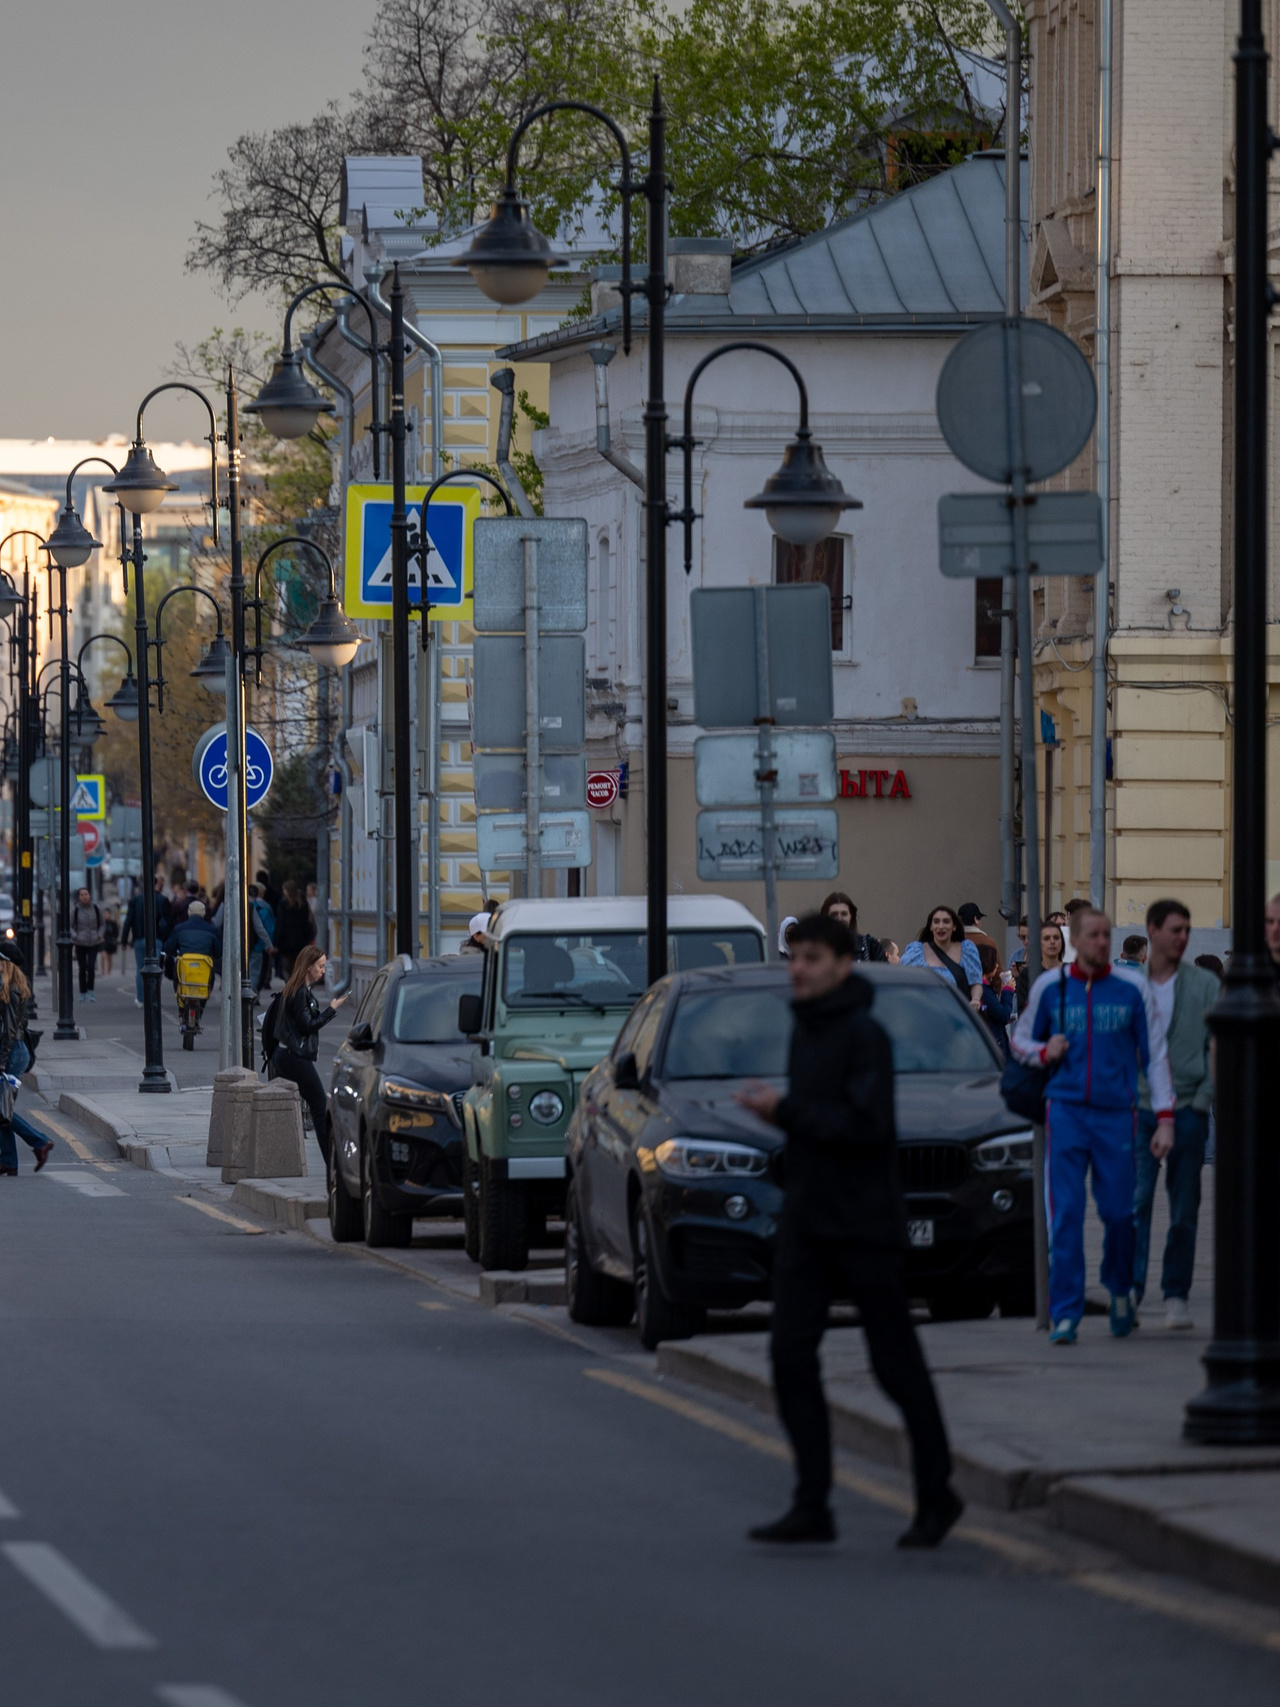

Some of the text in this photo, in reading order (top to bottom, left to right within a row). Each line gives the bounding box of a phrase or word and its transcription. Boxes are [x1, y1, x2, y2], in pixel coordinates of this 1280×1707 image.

[587, 782, 612, 790] РЕМОНТ
[839, 770, 911, 798] ЫТА
[590, 790, 609, 798] ЧАСОВ
